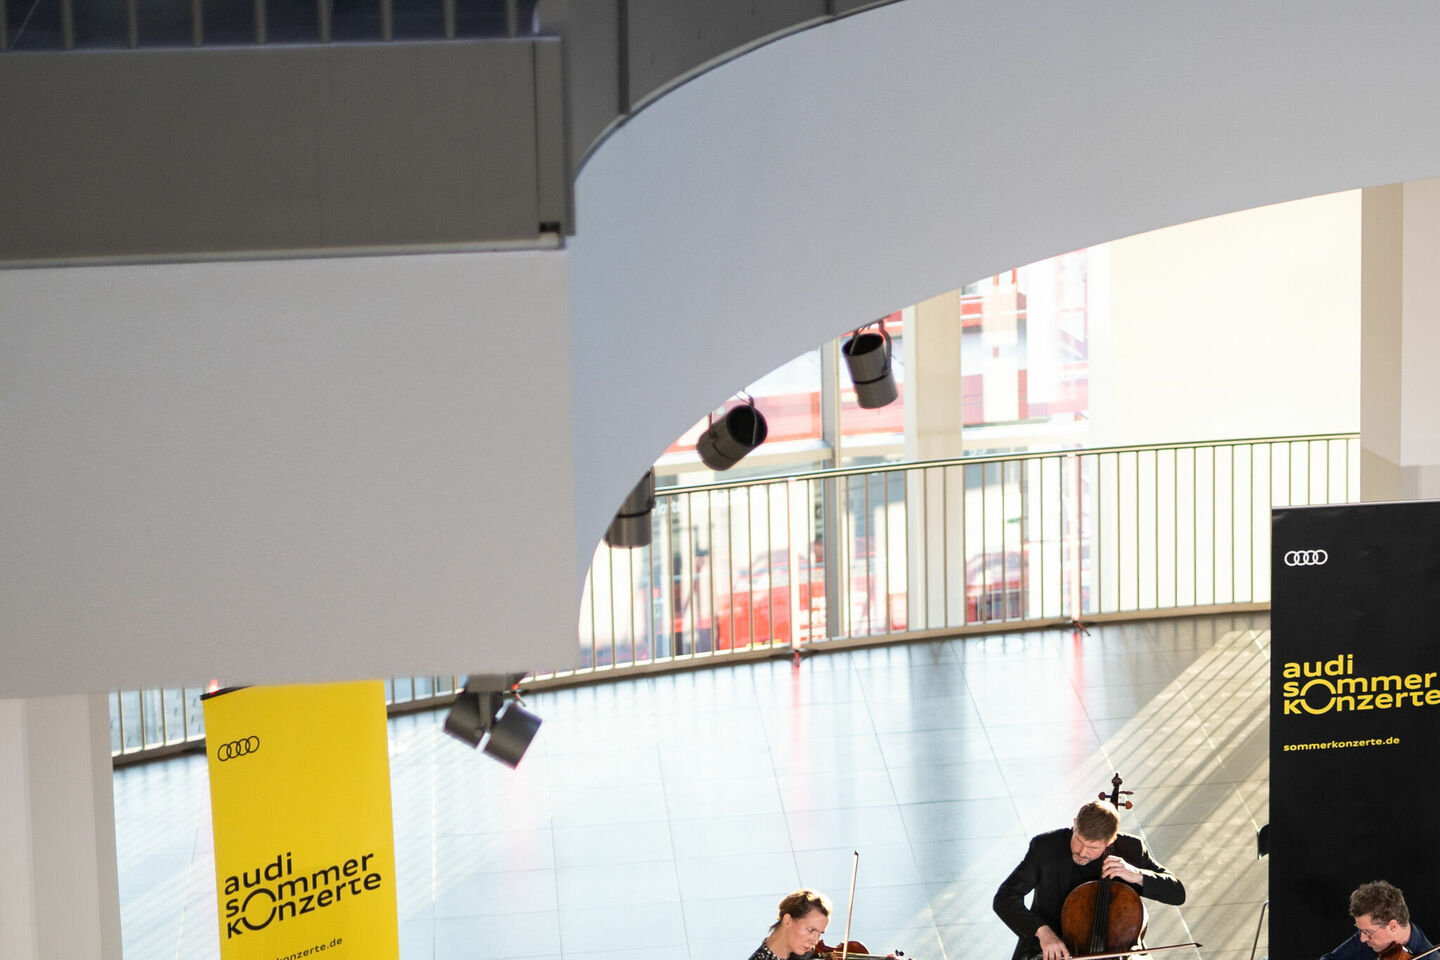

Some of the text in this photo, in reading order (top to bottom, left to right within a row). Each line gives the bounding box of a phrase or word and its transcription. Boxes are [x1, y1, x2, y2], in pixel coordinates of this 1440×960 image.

[1282, 653, 1354, 679] audi
[1283, 736, 1401, 752] sommerkonzerte.de
[224, 852, 292, 896] audi
